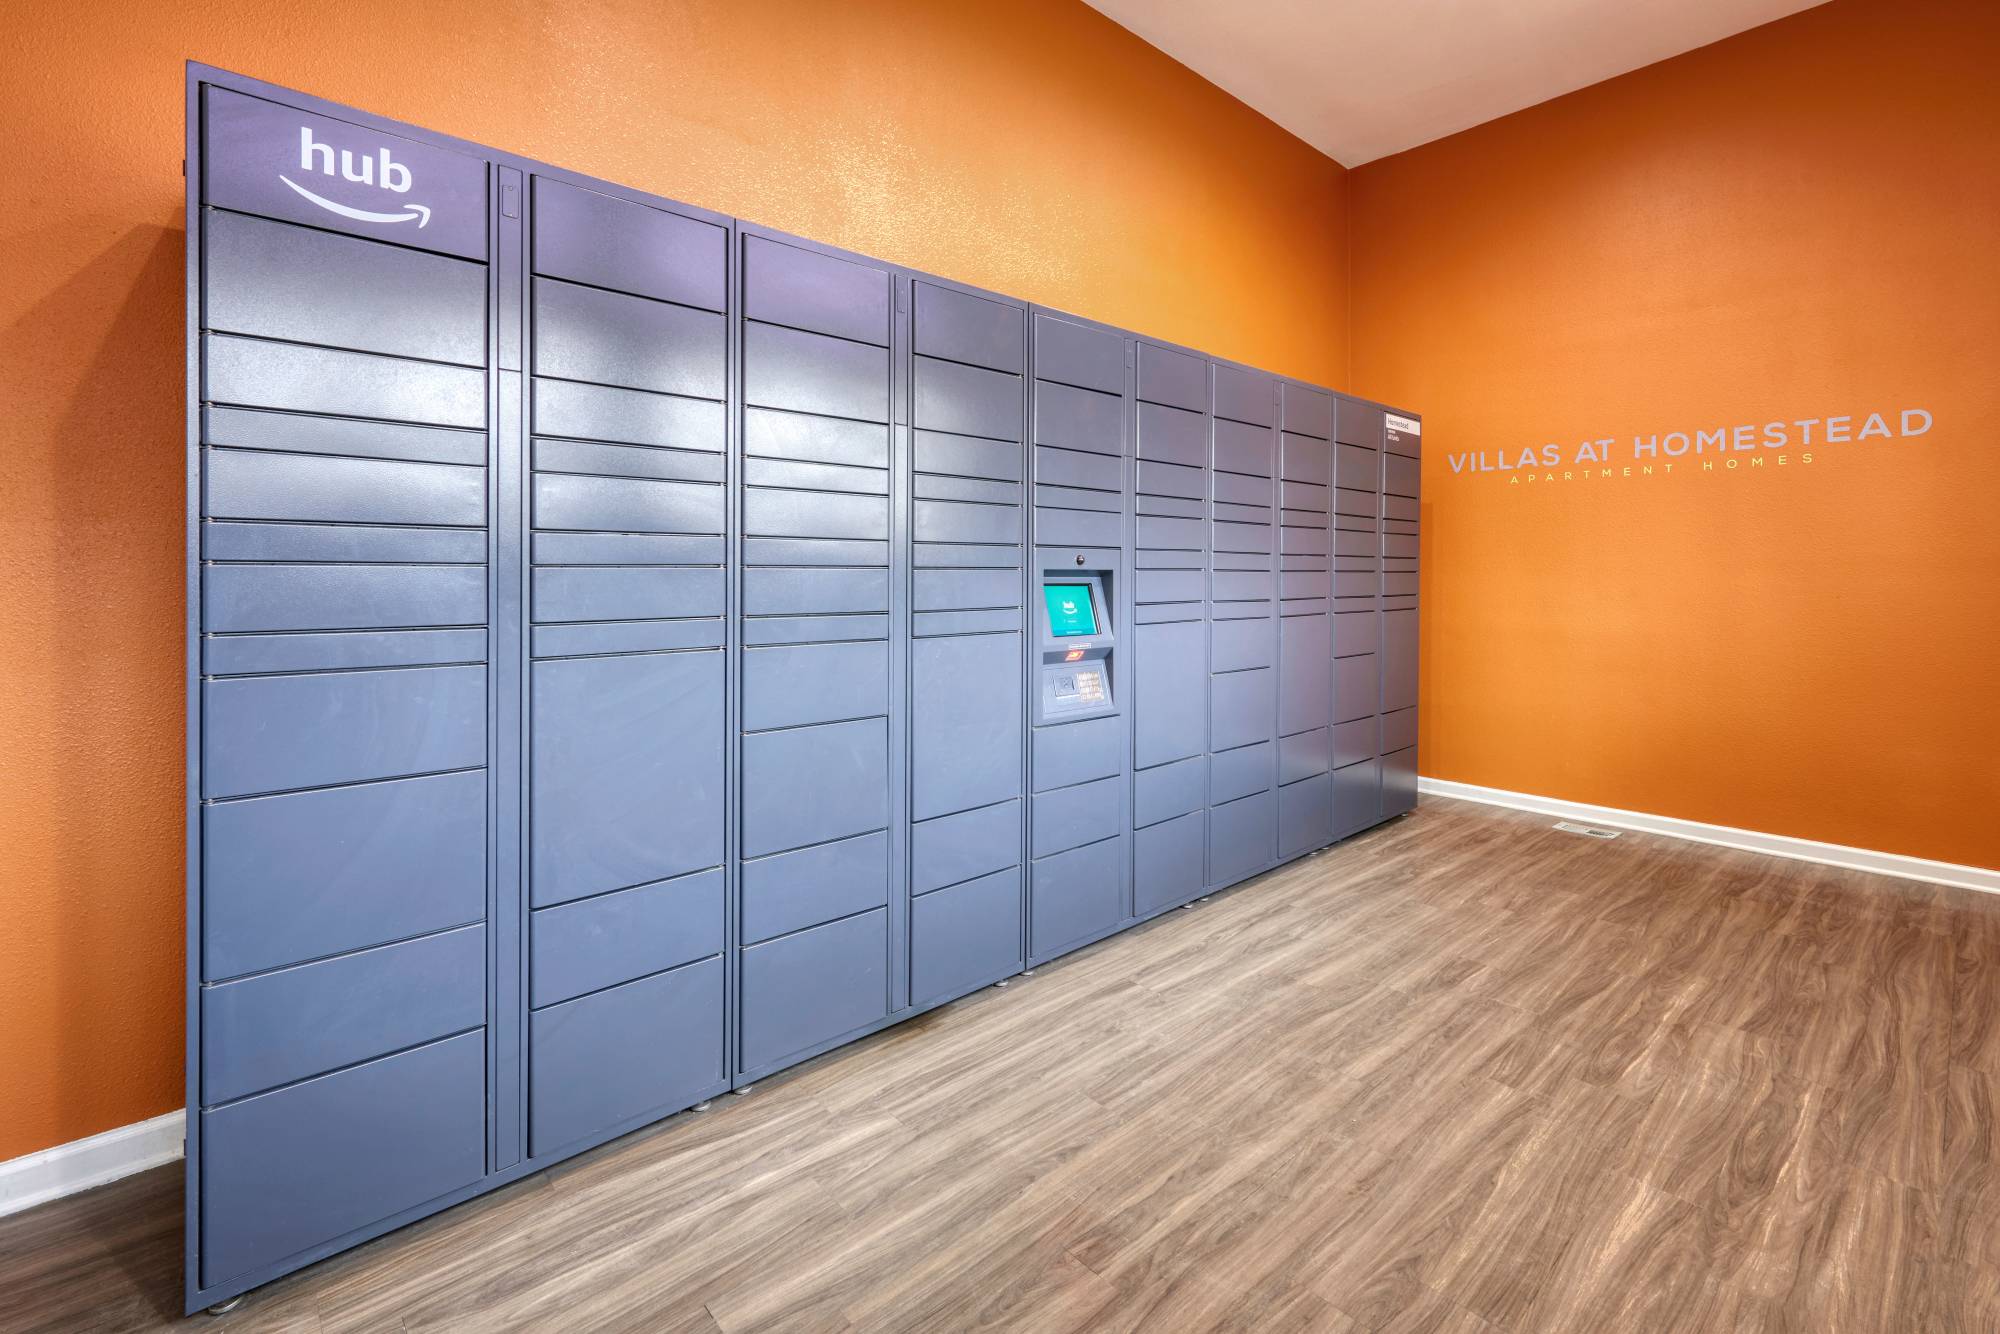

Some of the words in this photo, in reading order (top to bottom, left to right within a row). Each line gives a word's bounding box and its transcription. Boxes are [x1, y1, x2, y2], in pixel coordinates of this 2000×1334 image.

[301, 126, 412, 193] hub
[1448, 444, 1561, 473] VILLAS
[1574, 439, 1616, 464] AT
[1634, 409, 1933, 459] HOMESTEAD
[1510, 464, 1672, 485] APARTMENT
[1703, 453, 1813, 471] HOMES
